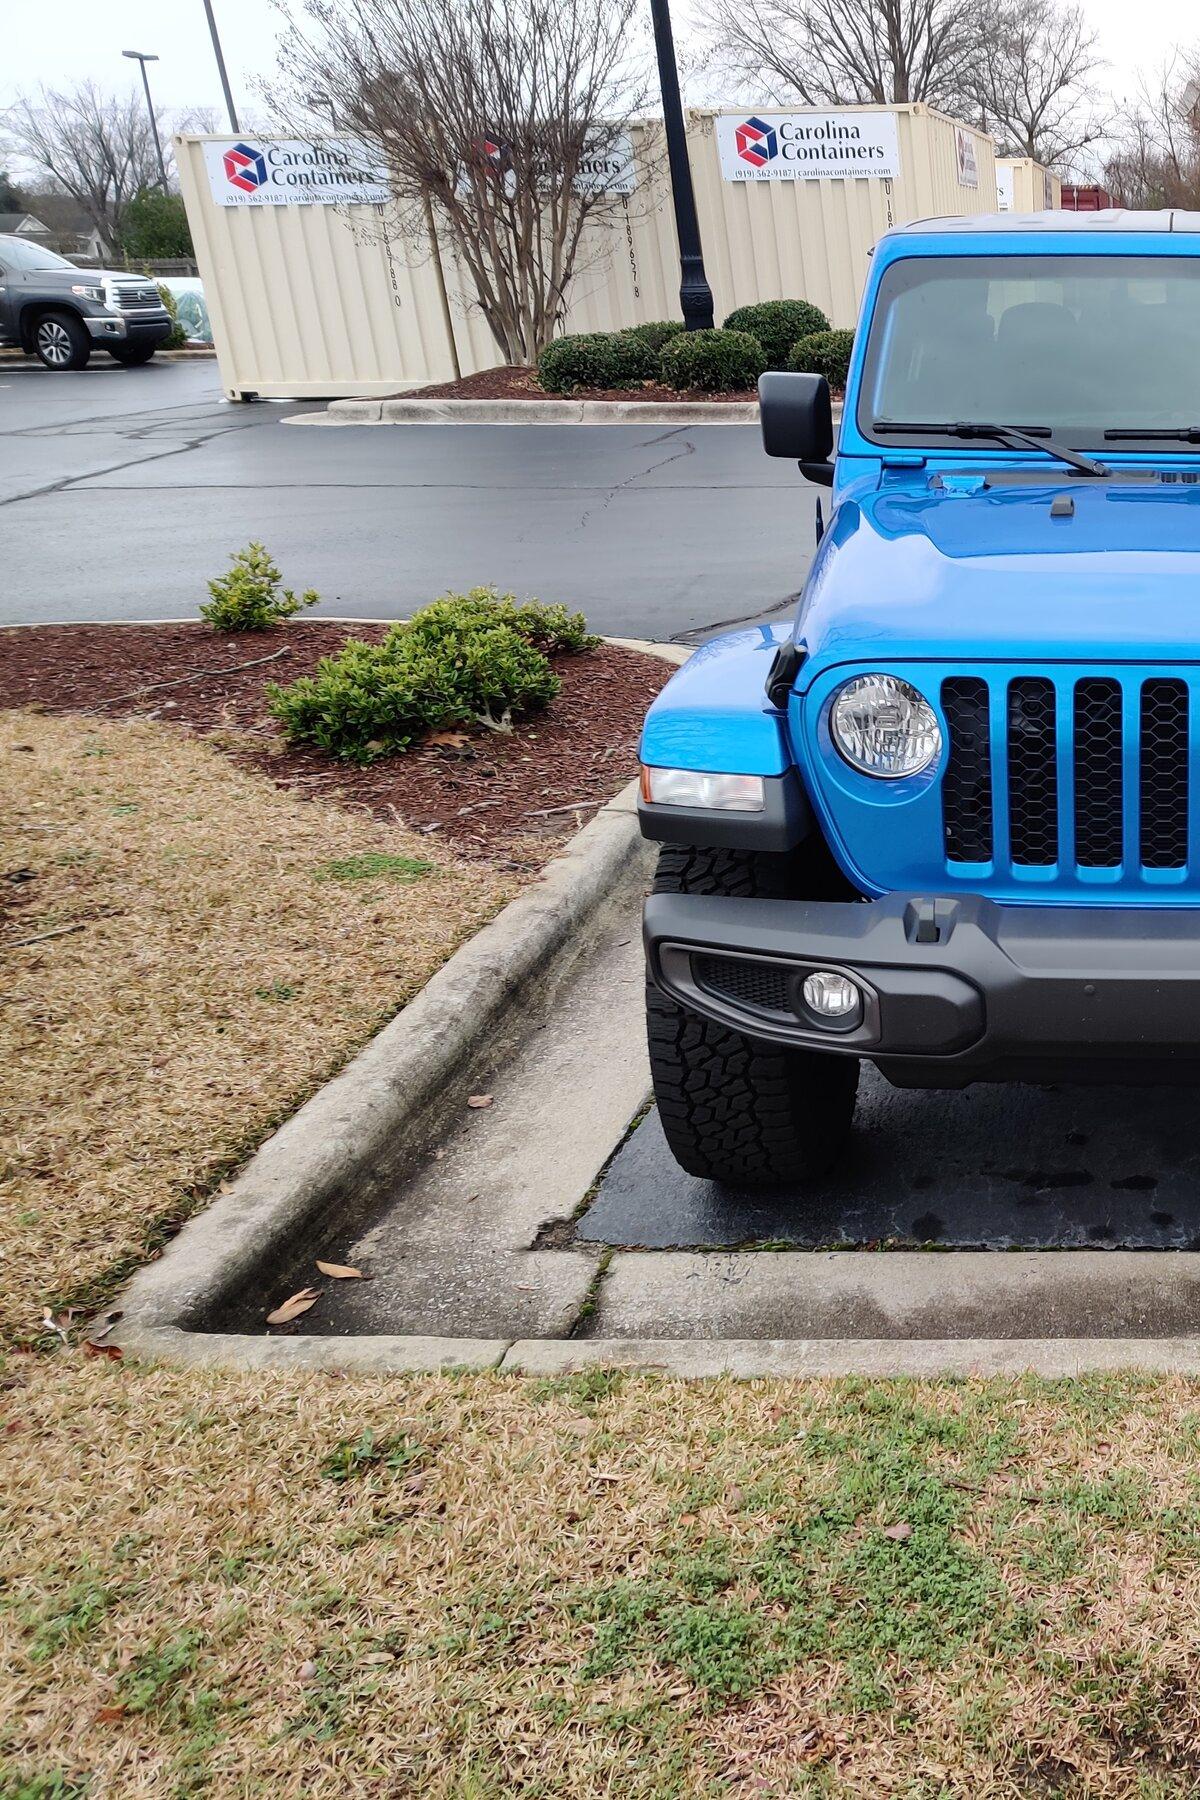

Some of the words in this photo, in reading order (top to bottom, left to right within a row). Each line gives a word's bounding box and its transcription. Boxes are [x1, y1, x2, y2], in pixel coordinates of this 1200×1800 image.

[779, 120, 861, 141] Carolina
[267, 147, 349, 167] Carolina
[781, 141, 885, 161] Containers
[271, 167, 375, 187] Containers
[735, 169, 755, 179] (919)
[757, 168, 792, 178] 562-9187
[797, 166, 891, 178] carolinacontainers.com
[226, 193, 246, 203] (919)
[248, 193, 284, 203] 562-9187
